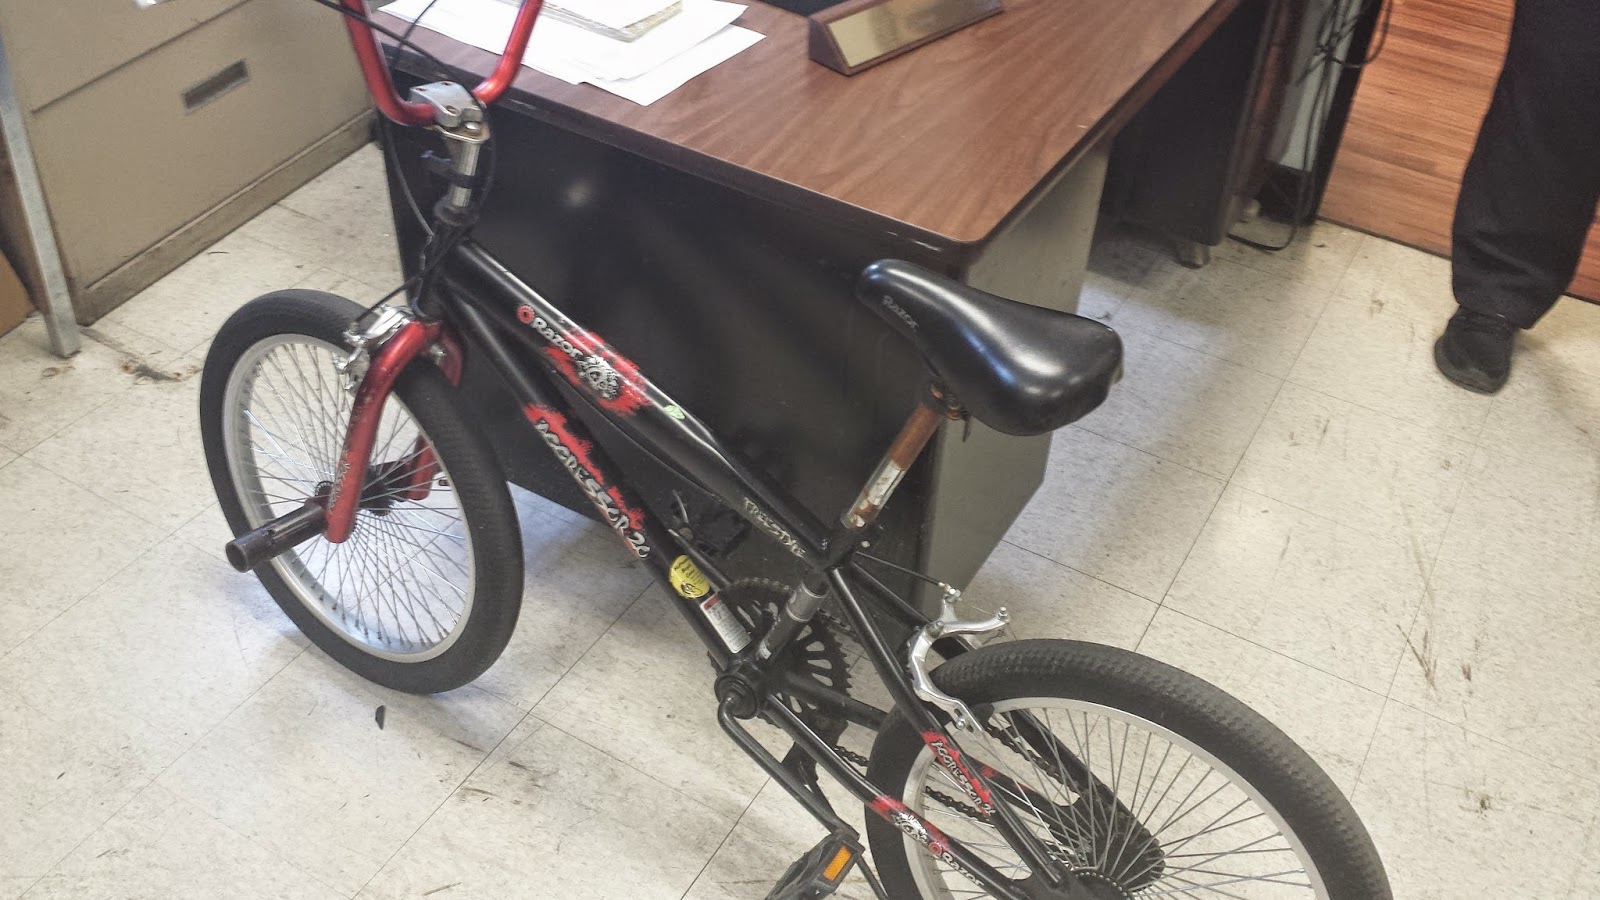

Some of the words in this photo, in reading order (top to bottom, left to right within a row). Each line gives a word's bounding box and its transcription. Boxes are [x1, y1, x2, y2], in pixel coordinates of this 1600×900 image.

[530, 317, 584, 359] Razor
[931, 740, 983, 807] AGGRESSOR
[941, 851, 985, 887] Razor
